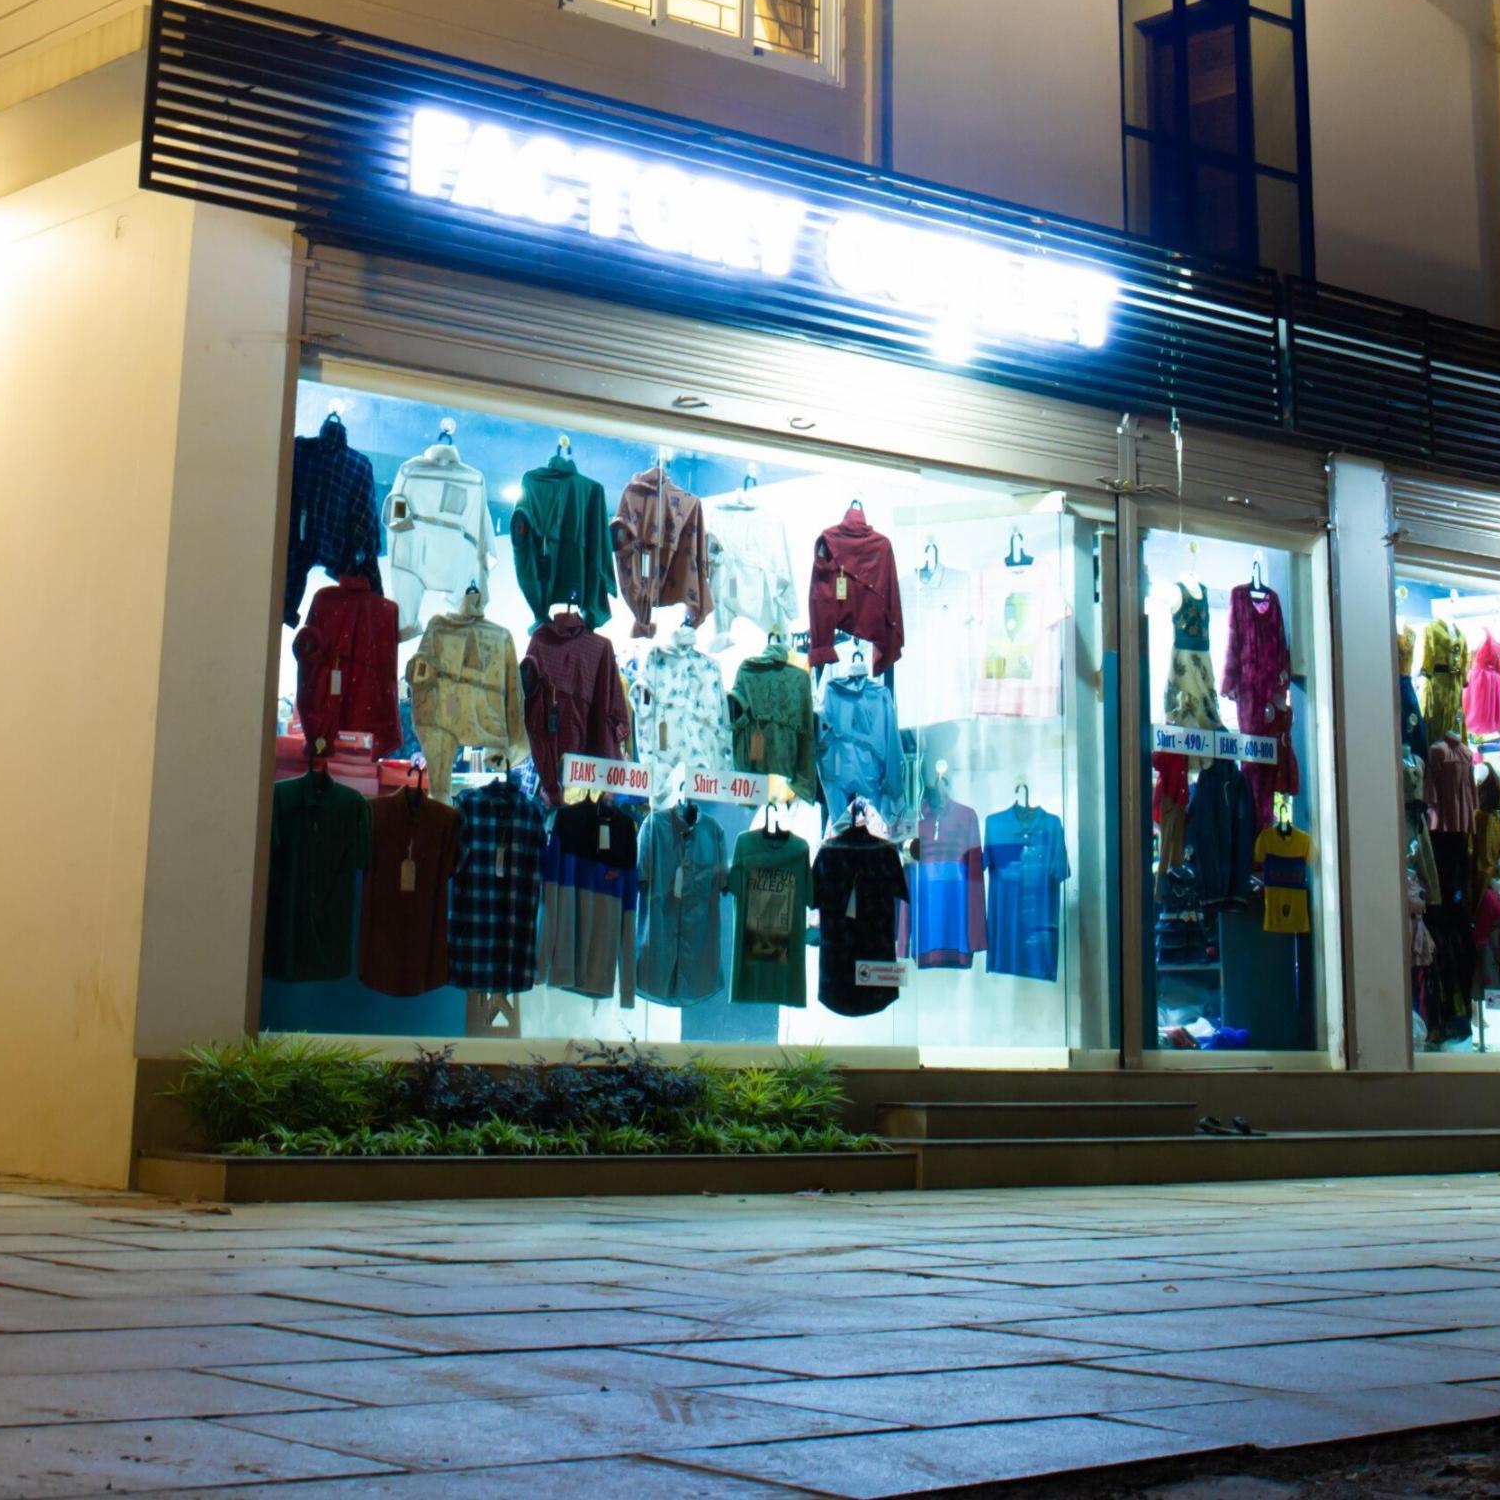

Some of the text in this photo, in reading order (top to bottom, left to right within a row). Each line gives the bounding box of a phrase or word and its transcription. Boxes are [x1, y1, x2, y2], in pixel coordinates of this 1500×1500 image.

[409, 108, 806, 277] FACTORY
[1156, 730, 1175, 749] Shirt
[1184, 733, 1209, 752] 490/-
[569, 761, 597, 784] JEANS
[606, 767, 648, 790] 600-800
[694, 773, 718, 795] Shirt
[730, 778, 761, 799] 470/-
[747, 877, 786, 893] FILLED
